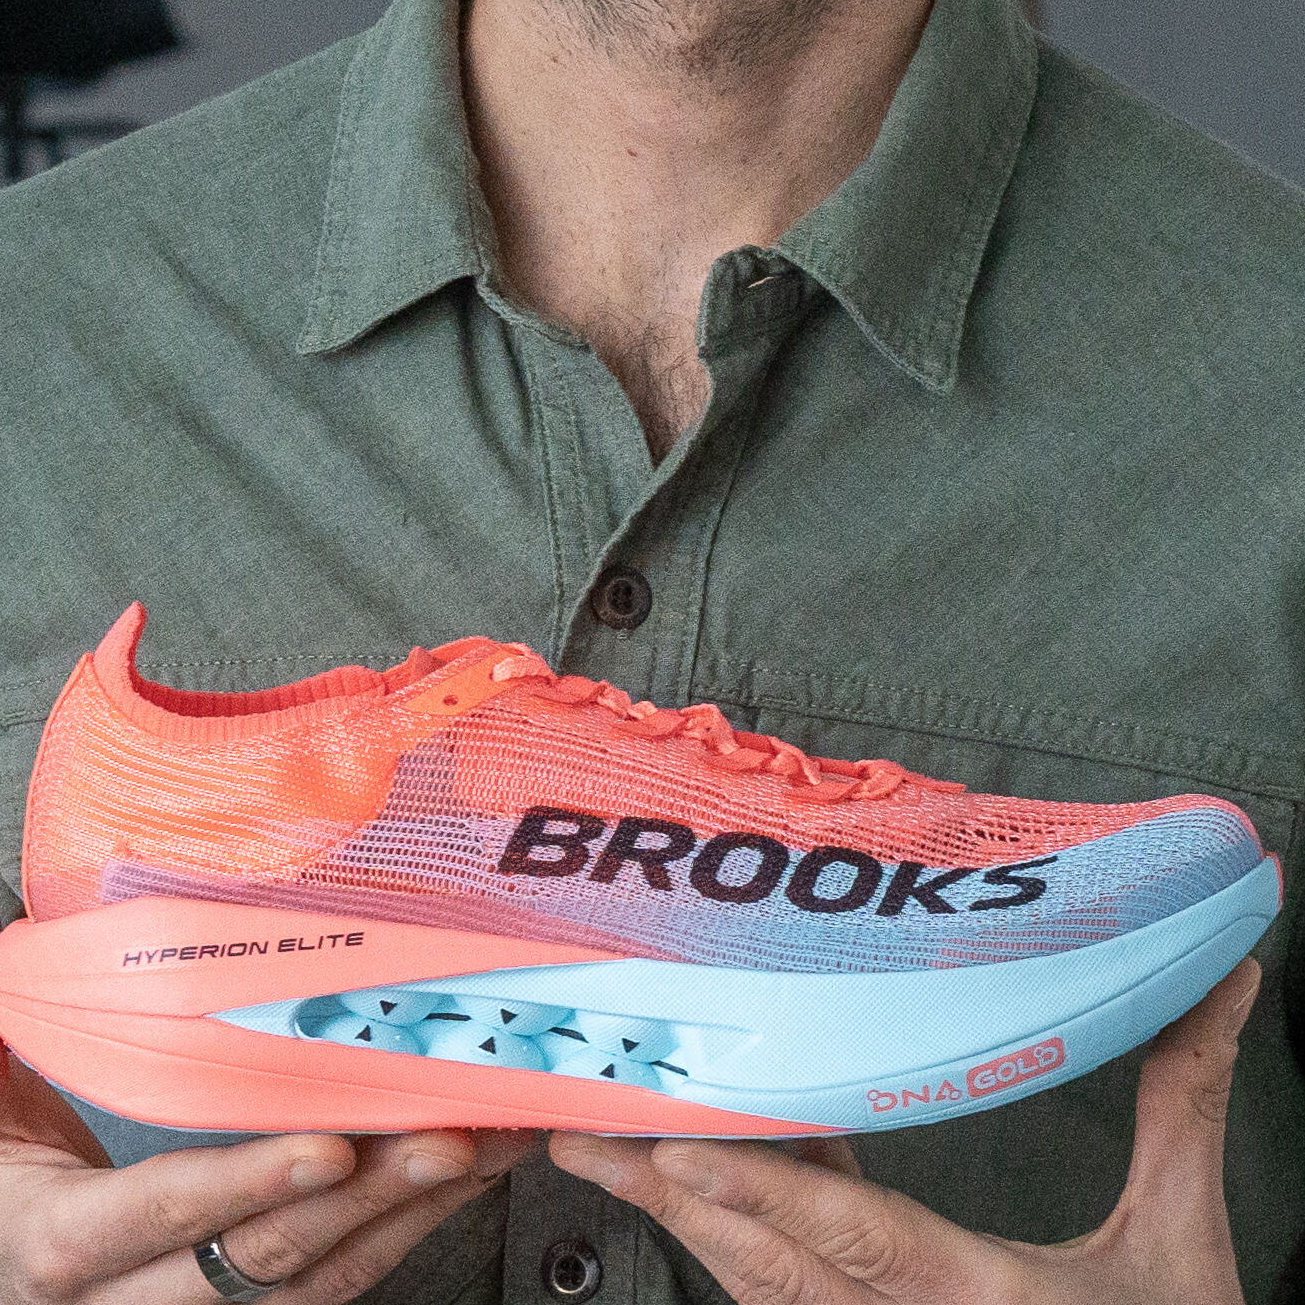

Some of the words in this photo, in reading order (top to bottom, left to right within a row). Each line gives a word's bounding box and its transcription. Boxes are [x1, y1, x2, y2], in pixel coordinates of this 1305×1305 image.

[498, 804, 1058, 916] BROOKS
[122, 941, 269, 967] HYPERION
[277, 931, 365, 953] ELITE
[866, 1079, 962, 1113] DNA
[973, 1045, 1059, 1090] GOLD
